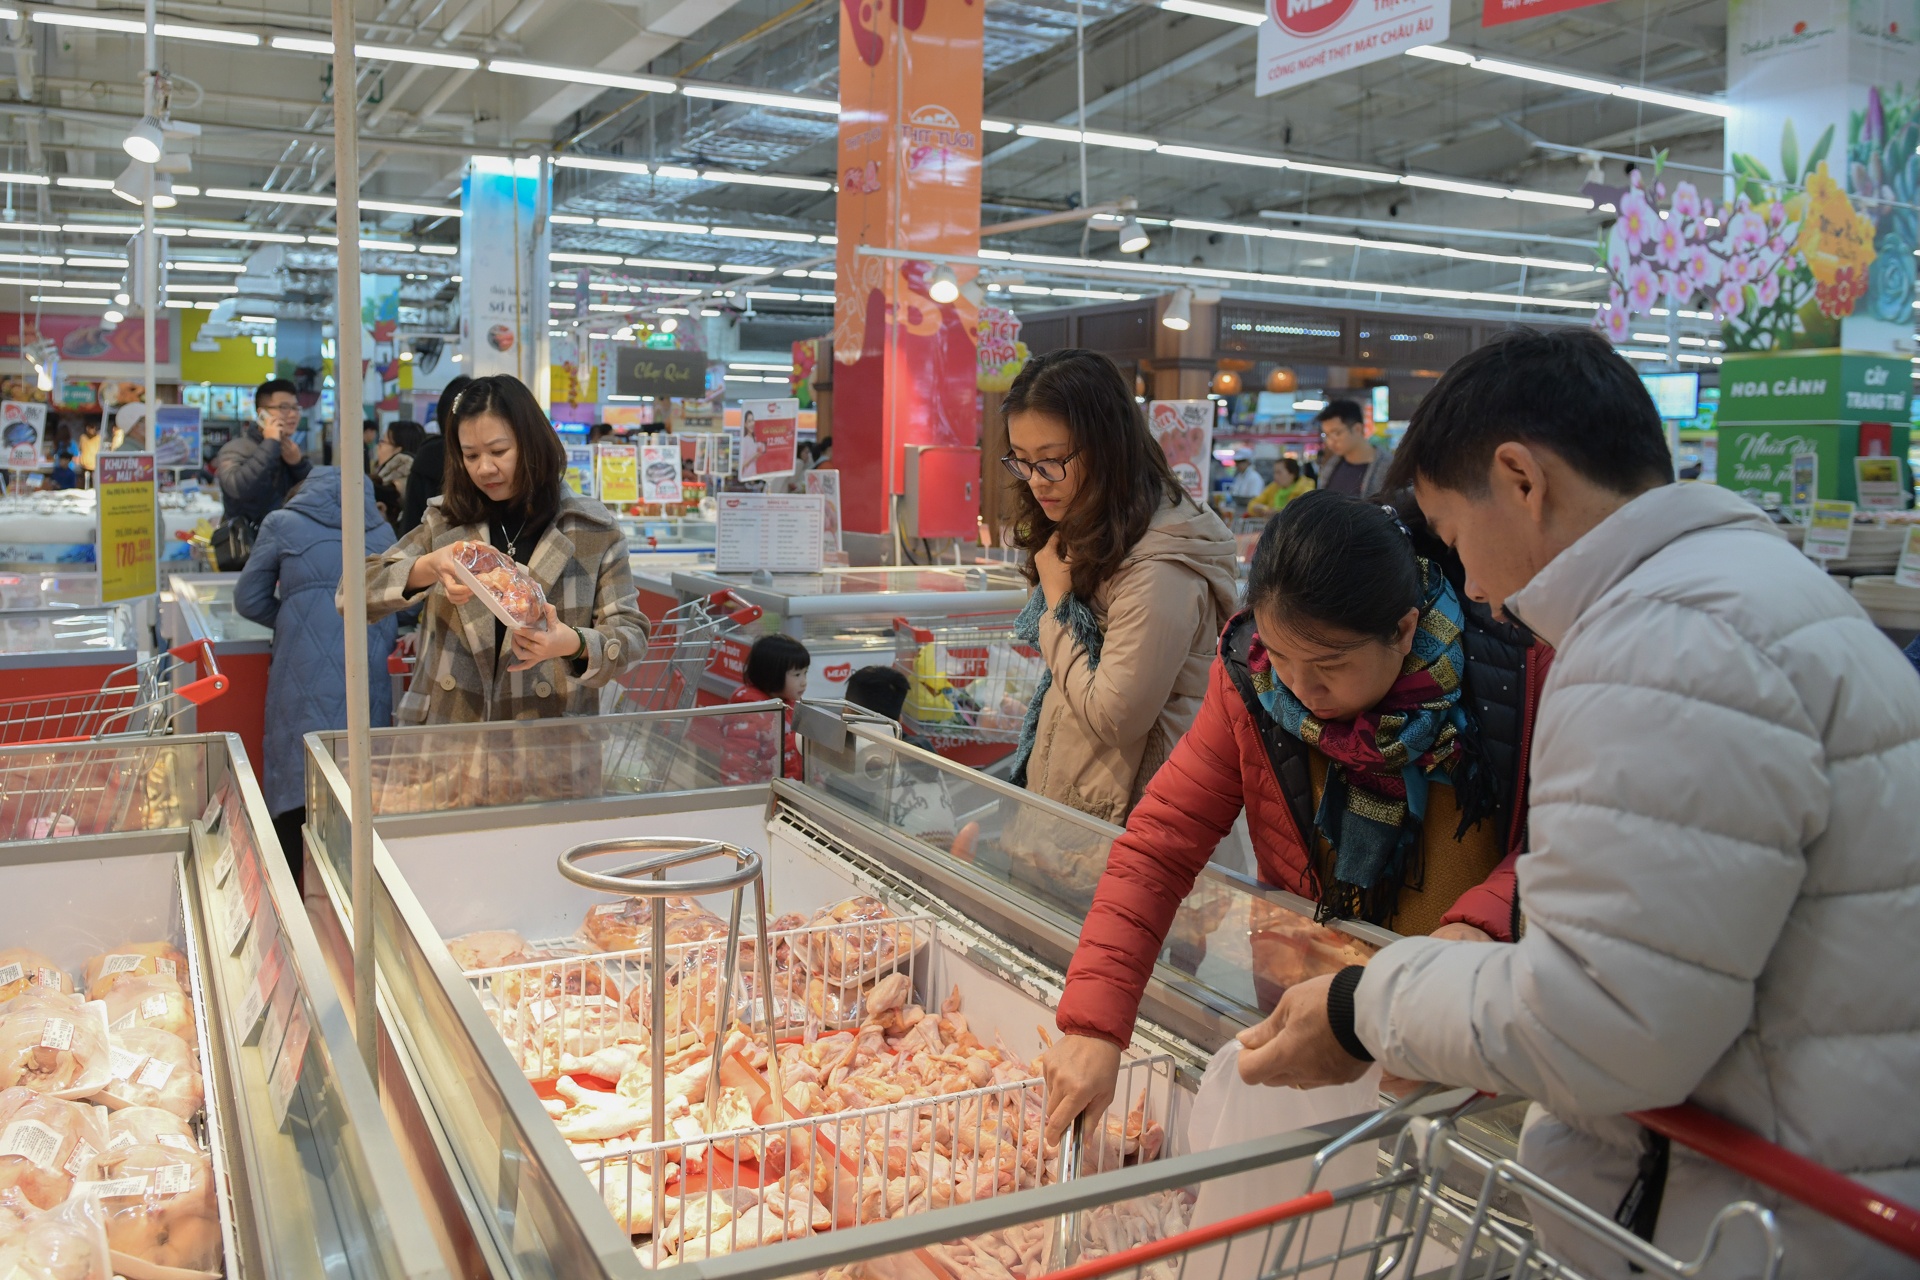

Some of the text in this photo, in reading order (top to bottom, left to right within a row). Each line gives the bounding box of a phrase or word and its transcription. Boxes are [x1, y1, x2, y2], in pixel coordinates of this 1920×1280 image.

[1268, 62, 1299, 82] CÔNG
[1353, 35, 1378, 53] MÁT
[1380, 22, 1414, 45] CHÂU
[1416, 16, 1434, 34] ÂU
[1730, 381, 1769, 398] HOA
